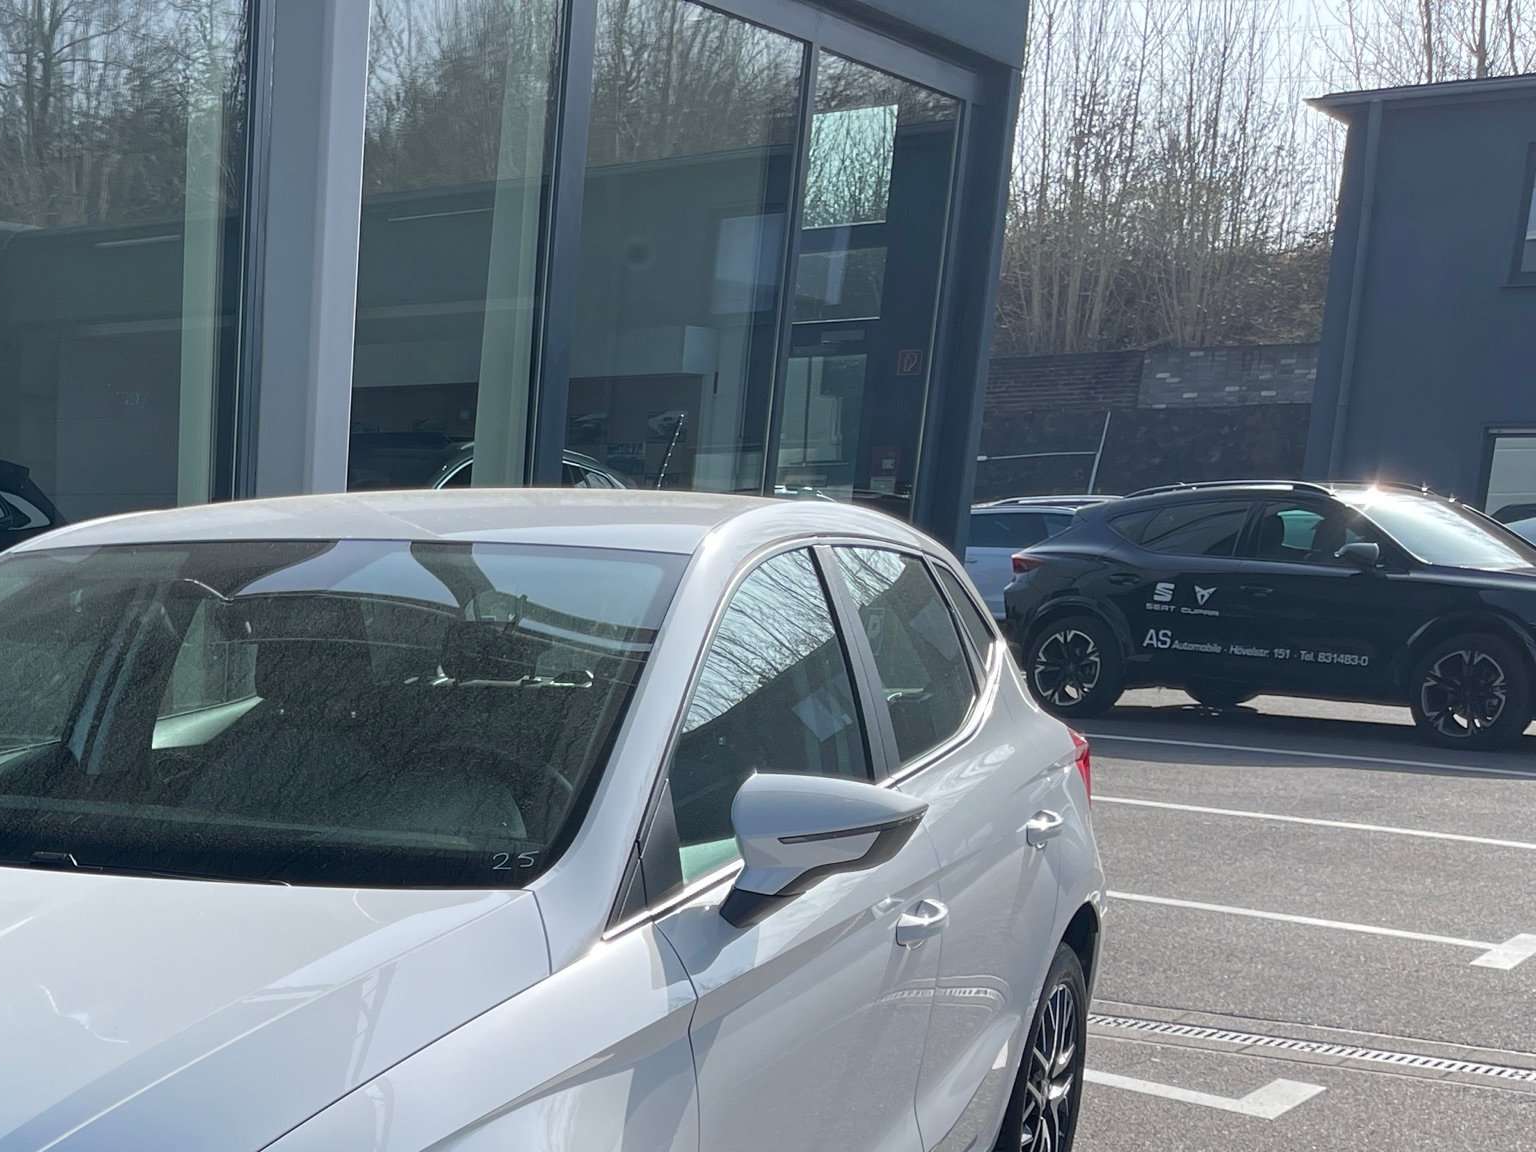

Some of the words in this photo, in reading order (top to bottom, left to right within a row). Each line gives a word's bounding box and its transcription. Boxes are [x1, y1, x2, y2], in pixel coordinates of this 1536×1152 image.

[1146, 602, 1176, 612] SEAT
[1143, 629, 1172, 649] AS
[1172, 640, 1222, 653] Automobile
[1274, 648, 1291, 660] 151
[1300, 650, 1315, 662] Tel.
